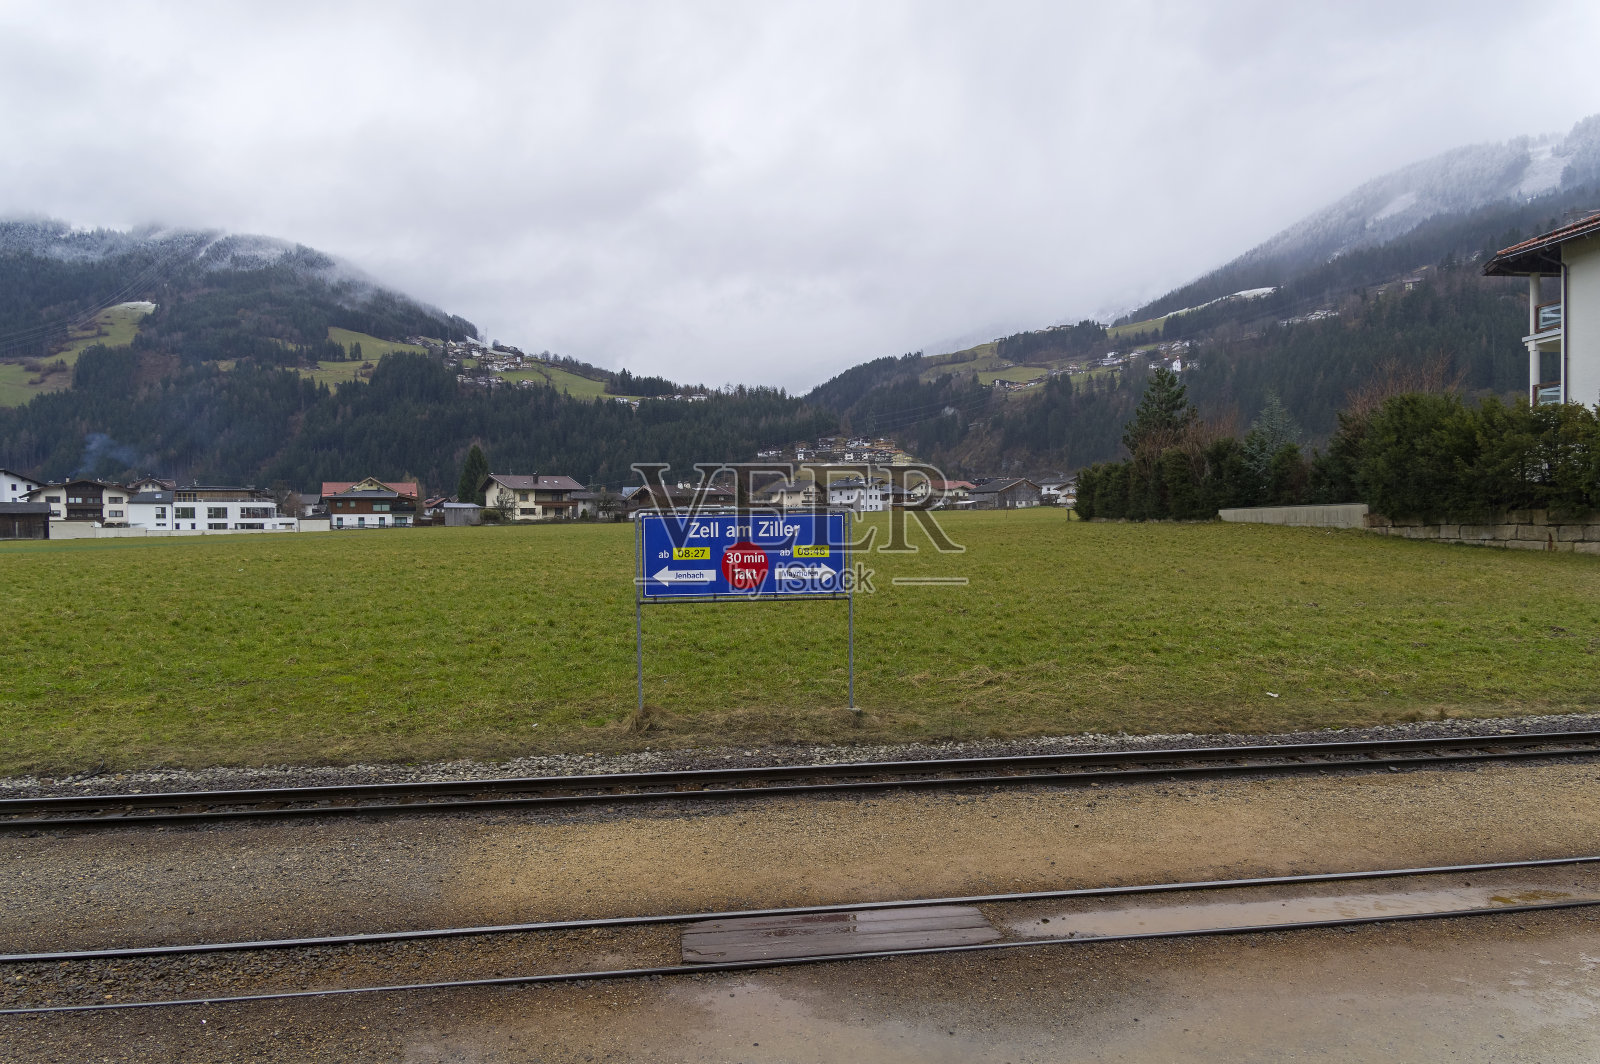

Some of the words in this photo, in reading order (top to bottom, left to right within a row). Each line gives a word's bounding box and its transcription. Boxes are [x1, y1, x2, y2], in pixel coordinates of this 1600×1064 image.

[689, 522, 719, 538] Zell
[726, 525, 752, 538] am
[758, 521, 800, 537] Ziller
[659, 550, 670, 558] ab
[678, 550, 706, 558] 08:27
[780, 548, 790, 556] ab
[798, 547, 826, 556] 08:46
[726, 552, 742, 564] 30
[744, 552, 764, 563] min
[675, 572, 704, 580] Jenbach
[733, 568, 757, 580] Takt
